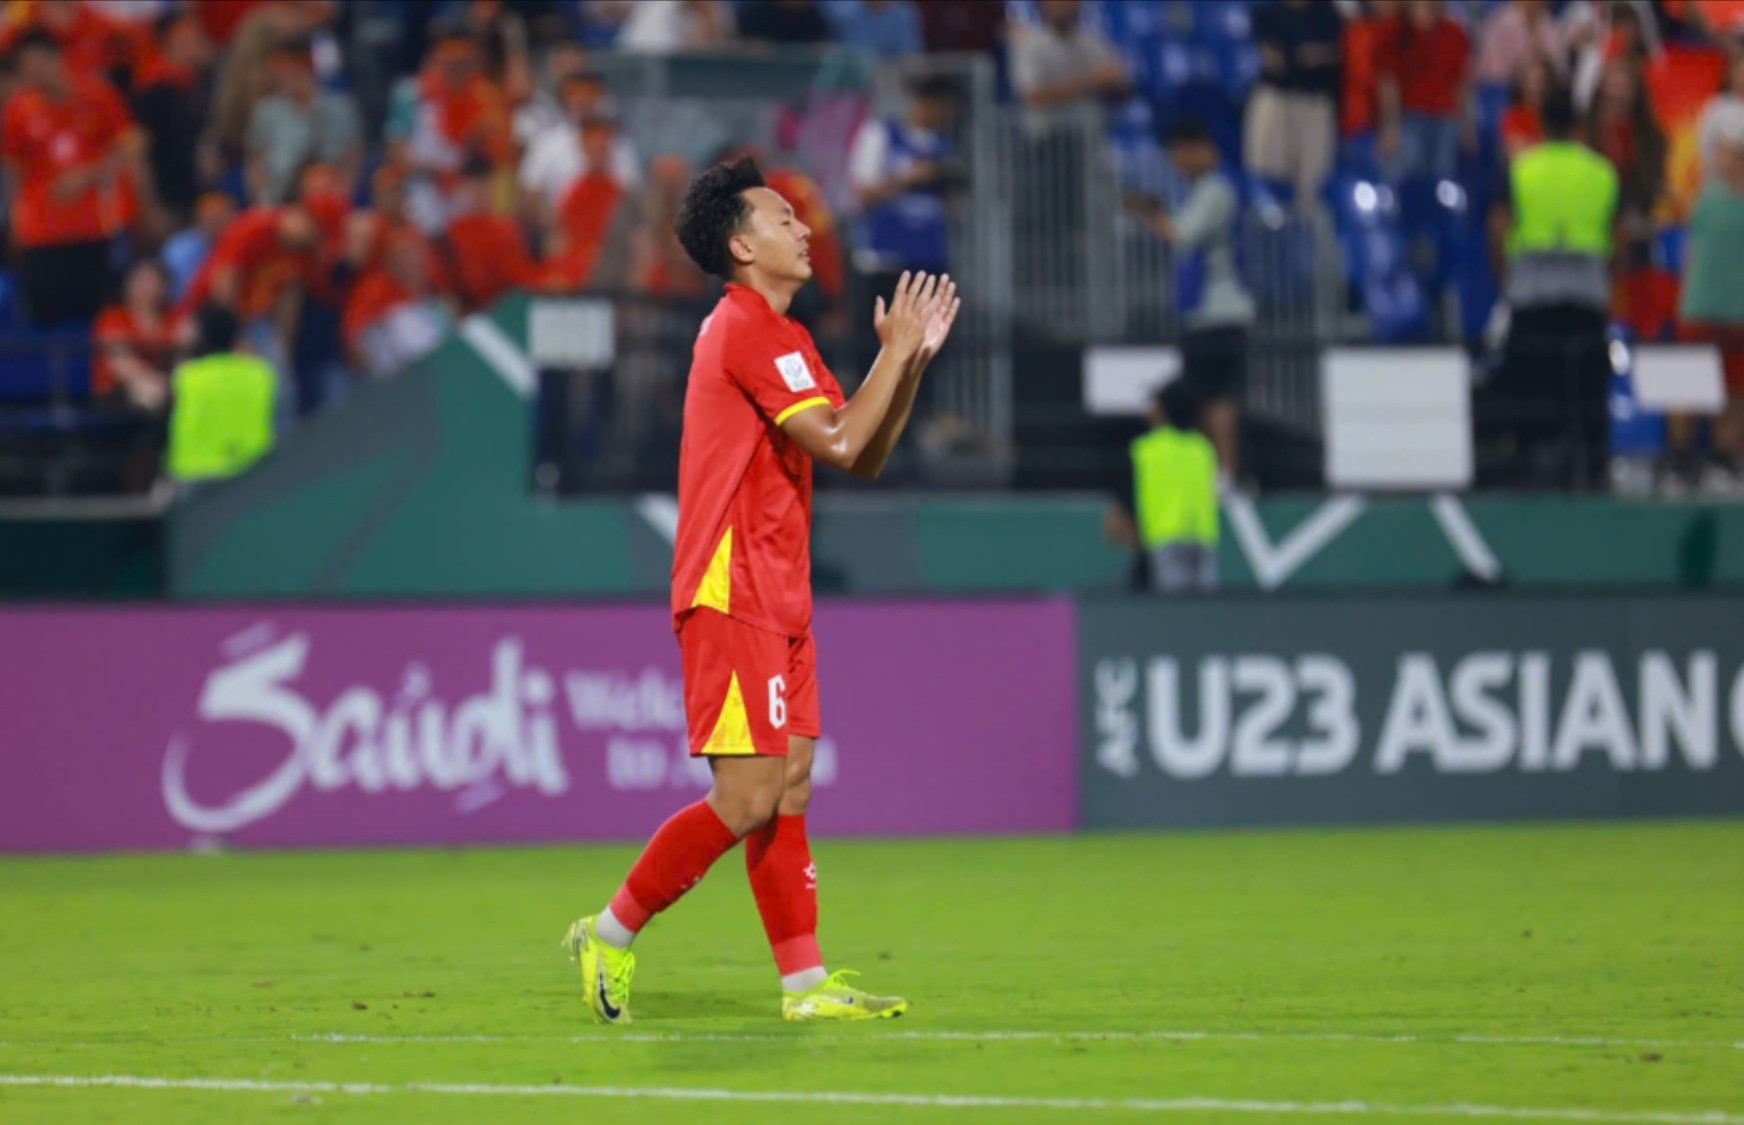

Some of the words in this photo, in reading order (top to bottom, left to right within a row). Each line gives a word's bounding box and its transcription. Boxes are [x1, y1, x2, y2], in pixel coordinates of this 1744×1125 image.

[162, 622, 569, 832] Saudi
[768, 674, 788, 730] 6
[1095, 657, 1139, 778] AFC
[1147, 653, 1360, 777] U23
[1374, 649, 1718, 771] ASIAN
